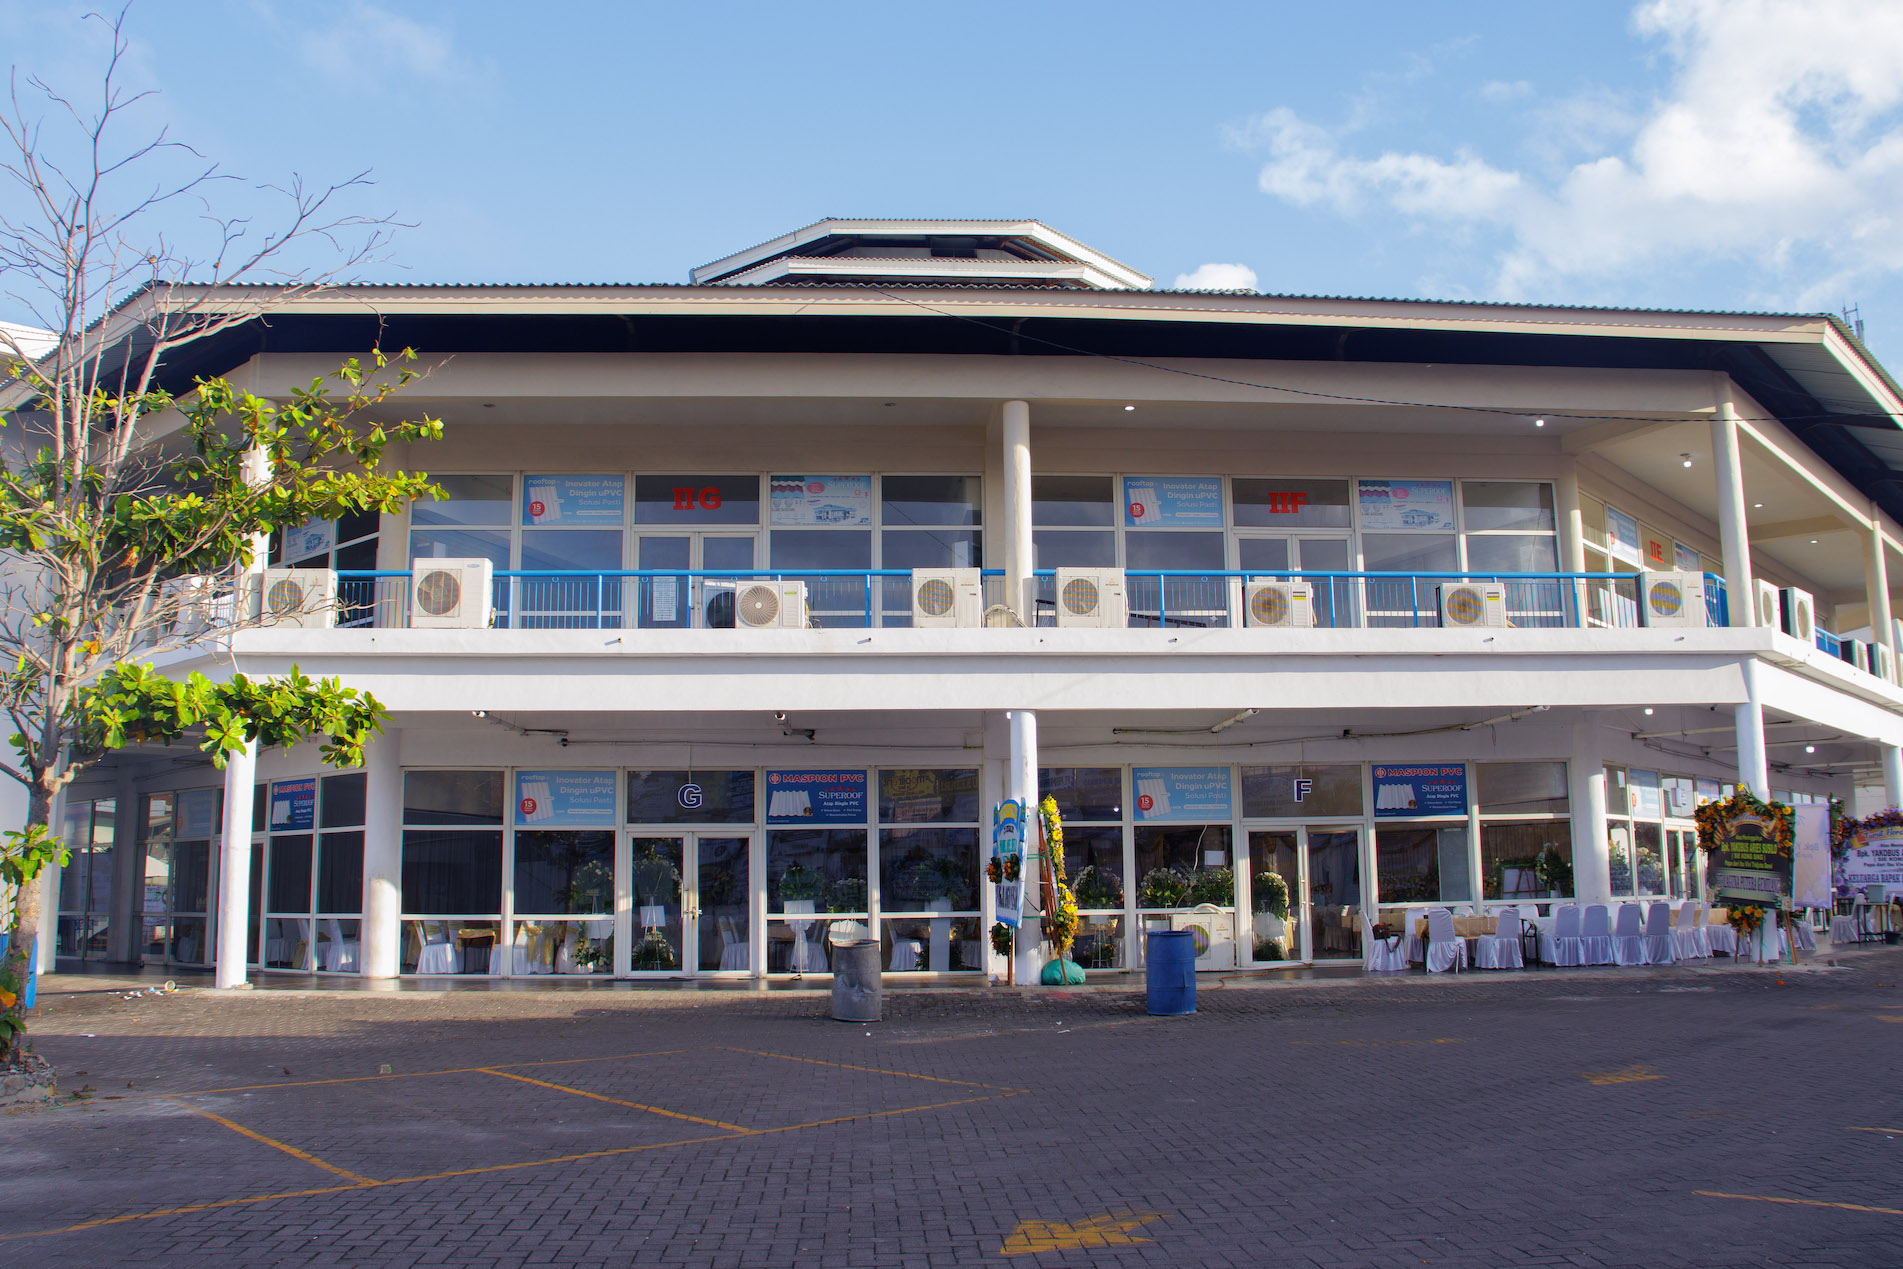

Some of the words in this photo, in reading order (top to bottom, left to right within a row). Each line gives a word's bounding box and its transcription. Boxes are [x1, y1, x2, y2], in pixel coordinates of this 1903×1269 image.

[601, 480, 623, 488] Atap
[1198, 483, 1218, 491] Atap
[569, 489, 597, 498] Dingin
[1167, 491, 1194, 500] Dingin
[672, 487, 722, 510] IIG
[1268, 492, 1307, 513] IIF
[1388, 768, 1438, 776] MASPION
[1441, 767, 1463, 776] PVC
[556, 776, 591, 784] Inovator
[593, 776, 614, 785] Atap
[782, 773, 837, 783] MASPION
[839, 773, 864, 783] PVC
[1207, 773, 1227, 781] Atap
[560, 786, 588, 795] Dingin
[589, 786, 614, 794] uPVC
[1175, 782, 1203, 791] Dingin
[1294, 779, 1312, 802] F
[1421, 784, 1462, 792] SUPEROOF
[678, 783, 702, 809] G
[818, 791, 863, 799] SUPEROOF
[1857, 850, 1869, 858] Bpk.
[1871, 849, 1900, 857] YAKOBUS
